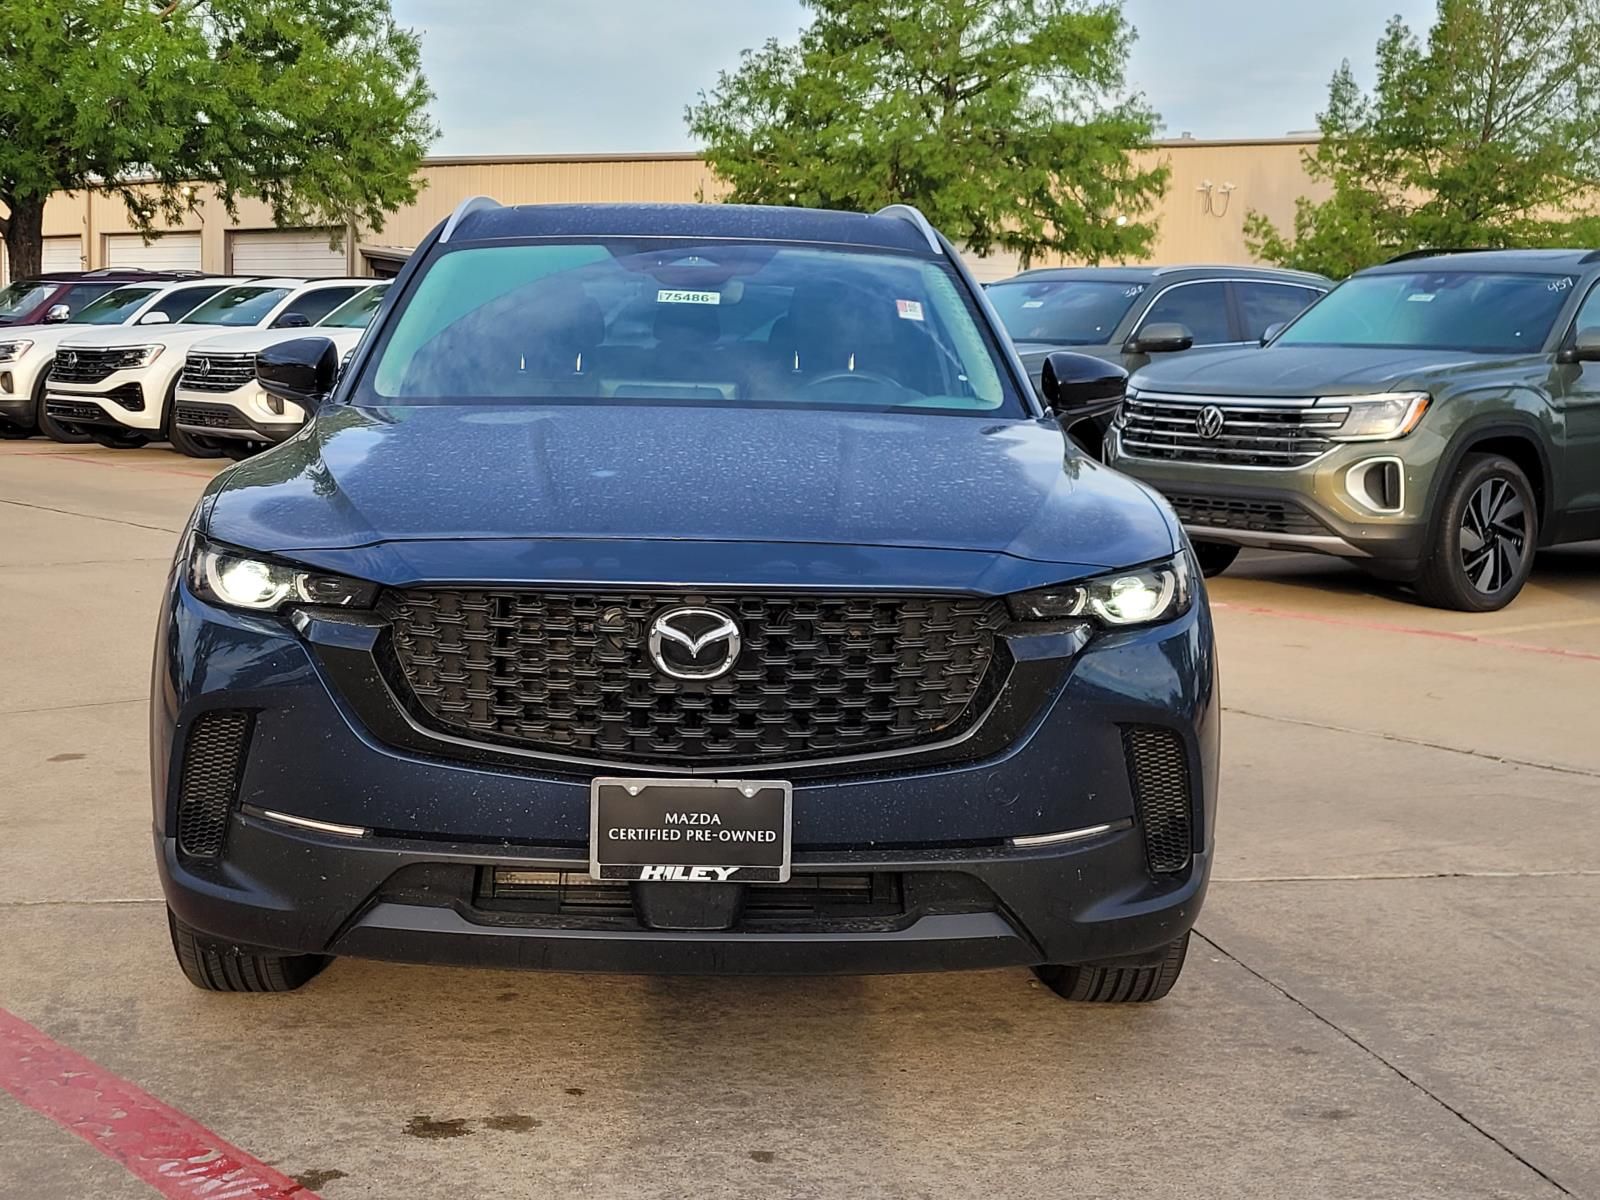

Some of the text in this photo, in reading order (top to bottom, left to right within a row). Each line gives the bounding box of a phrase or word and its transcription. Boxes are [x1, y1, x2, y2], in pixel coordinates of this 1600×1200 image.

[1547, 276, 1573, 292] 457
[664, 292, 710, 302] 75486
[664, 812, 722, 825] MAZDA
[608, 828, 777, 842] CERTIFIED PRE-OWNED
[639, 865, 741, 880] HILEY
